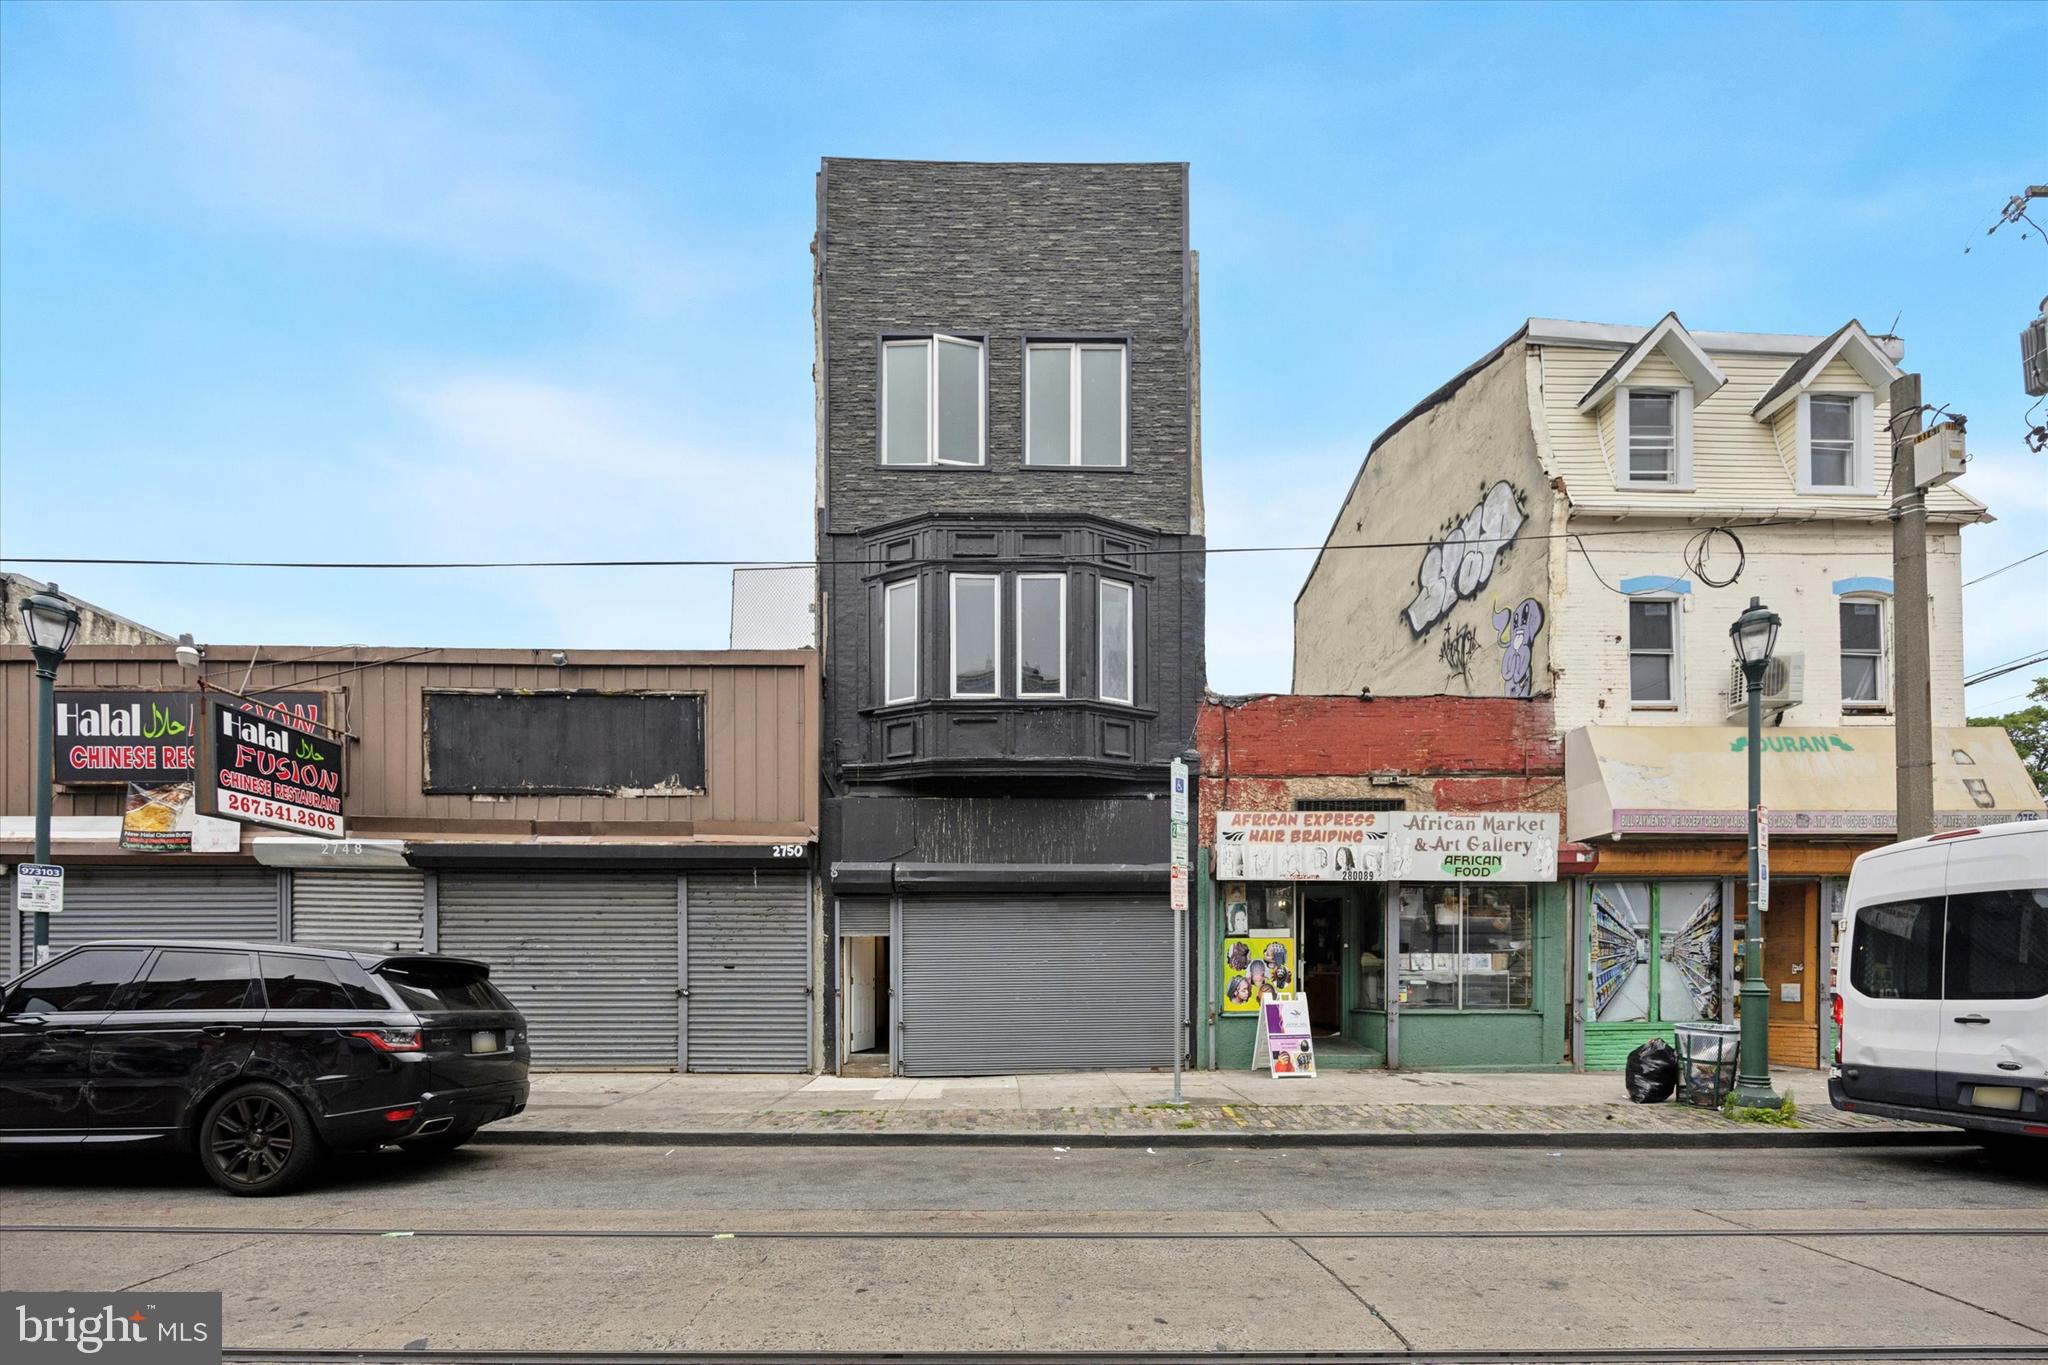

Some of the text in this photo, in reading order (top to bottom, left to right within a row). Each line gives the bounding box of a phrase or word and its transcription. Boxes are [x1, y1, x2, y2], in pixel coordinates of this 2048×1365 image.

[57, 703, 140, 736] Halal
[143, 702, 186, 738] حلال
[223, 711, 289, 754] Halal
[69, 745, 157, 769] CHINESE
[235, 744, 338, 792] FUSION
[219, 769, 341, 813] CHINESE RESTAURANT
[228, 794, 336, 831] 267.541.2808
[1231, 813, 1376, 827] AFRICAN EXPRESS
[1404, 815, 1545, 834] African Market
[1621, 815, 1634, 827] BILL
[1635, 815, 1666, 827] PAYMENTS
[1681, 815, 1704, 827] ACCEPT
[1705, 815, 1726, 827] CREDIT
[1727, 815, 1746, 827] CARDS
[1248, 829, 1365, 843] HAIR BRAIDING
[321, 843, 362, 855] 2748
[773, 845, 803, 857] 2750
[1415, 835, 1533, 857] & Art Gallery
[1444, 855, 1502, 866] AFRICAN
[21, 867, 60, 877] 973103
[1342, 870, 1374, 881] 280089
[1454, 867, 1491, 877] FOOD
